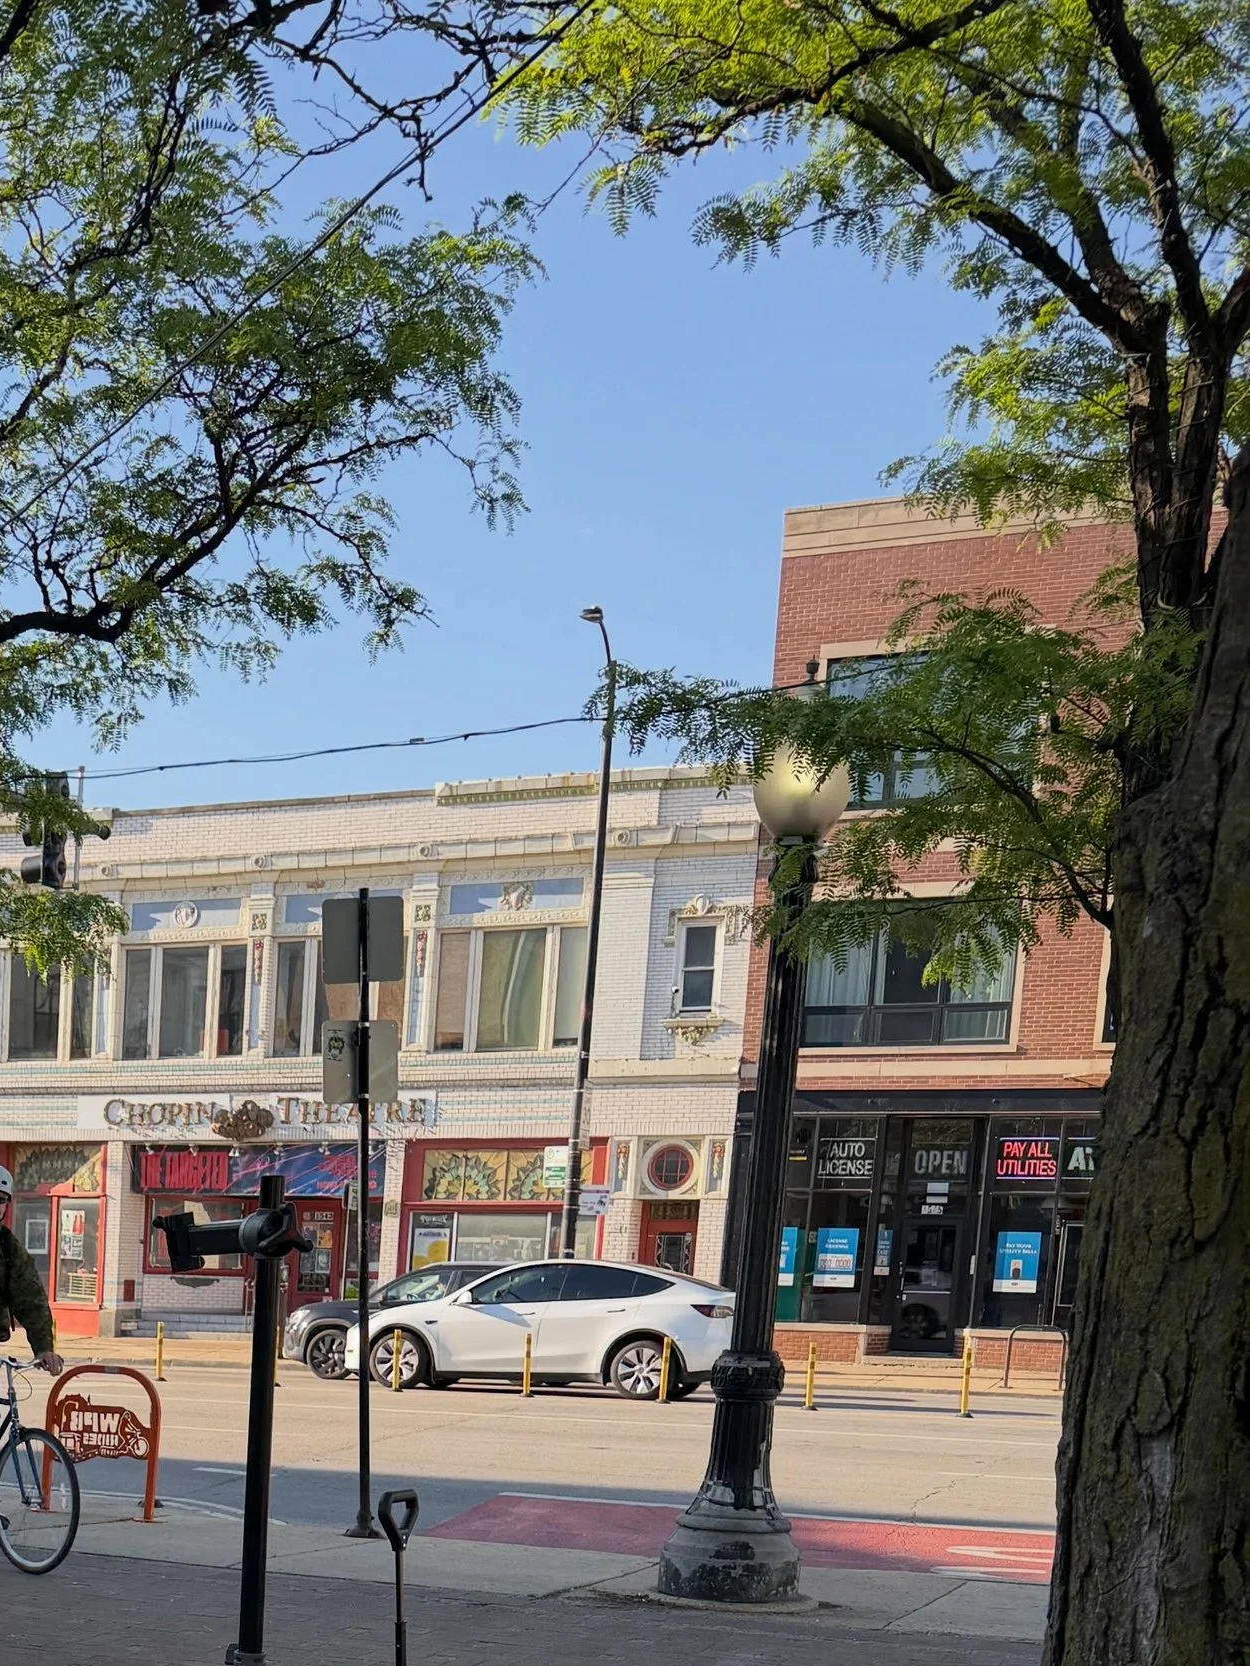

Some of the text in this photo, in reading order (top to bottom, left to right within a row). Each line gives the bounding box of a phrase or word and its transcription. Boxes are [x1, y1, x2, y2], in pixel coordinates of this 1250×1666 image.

[104, 1097, 428, 1127] CHOPIN THEATRE
[829, 1142, 865, 1158] AUTO
[1003, 1142, 1052, 1157] PAY ALL
[915, 1150, 967, 1175] OPEN
[1067, 1146, 1095, 1171] AT
[818, 1159, 873, 1176] LICENSE
[997, 1159, 1056, 1176] UTILITIES
